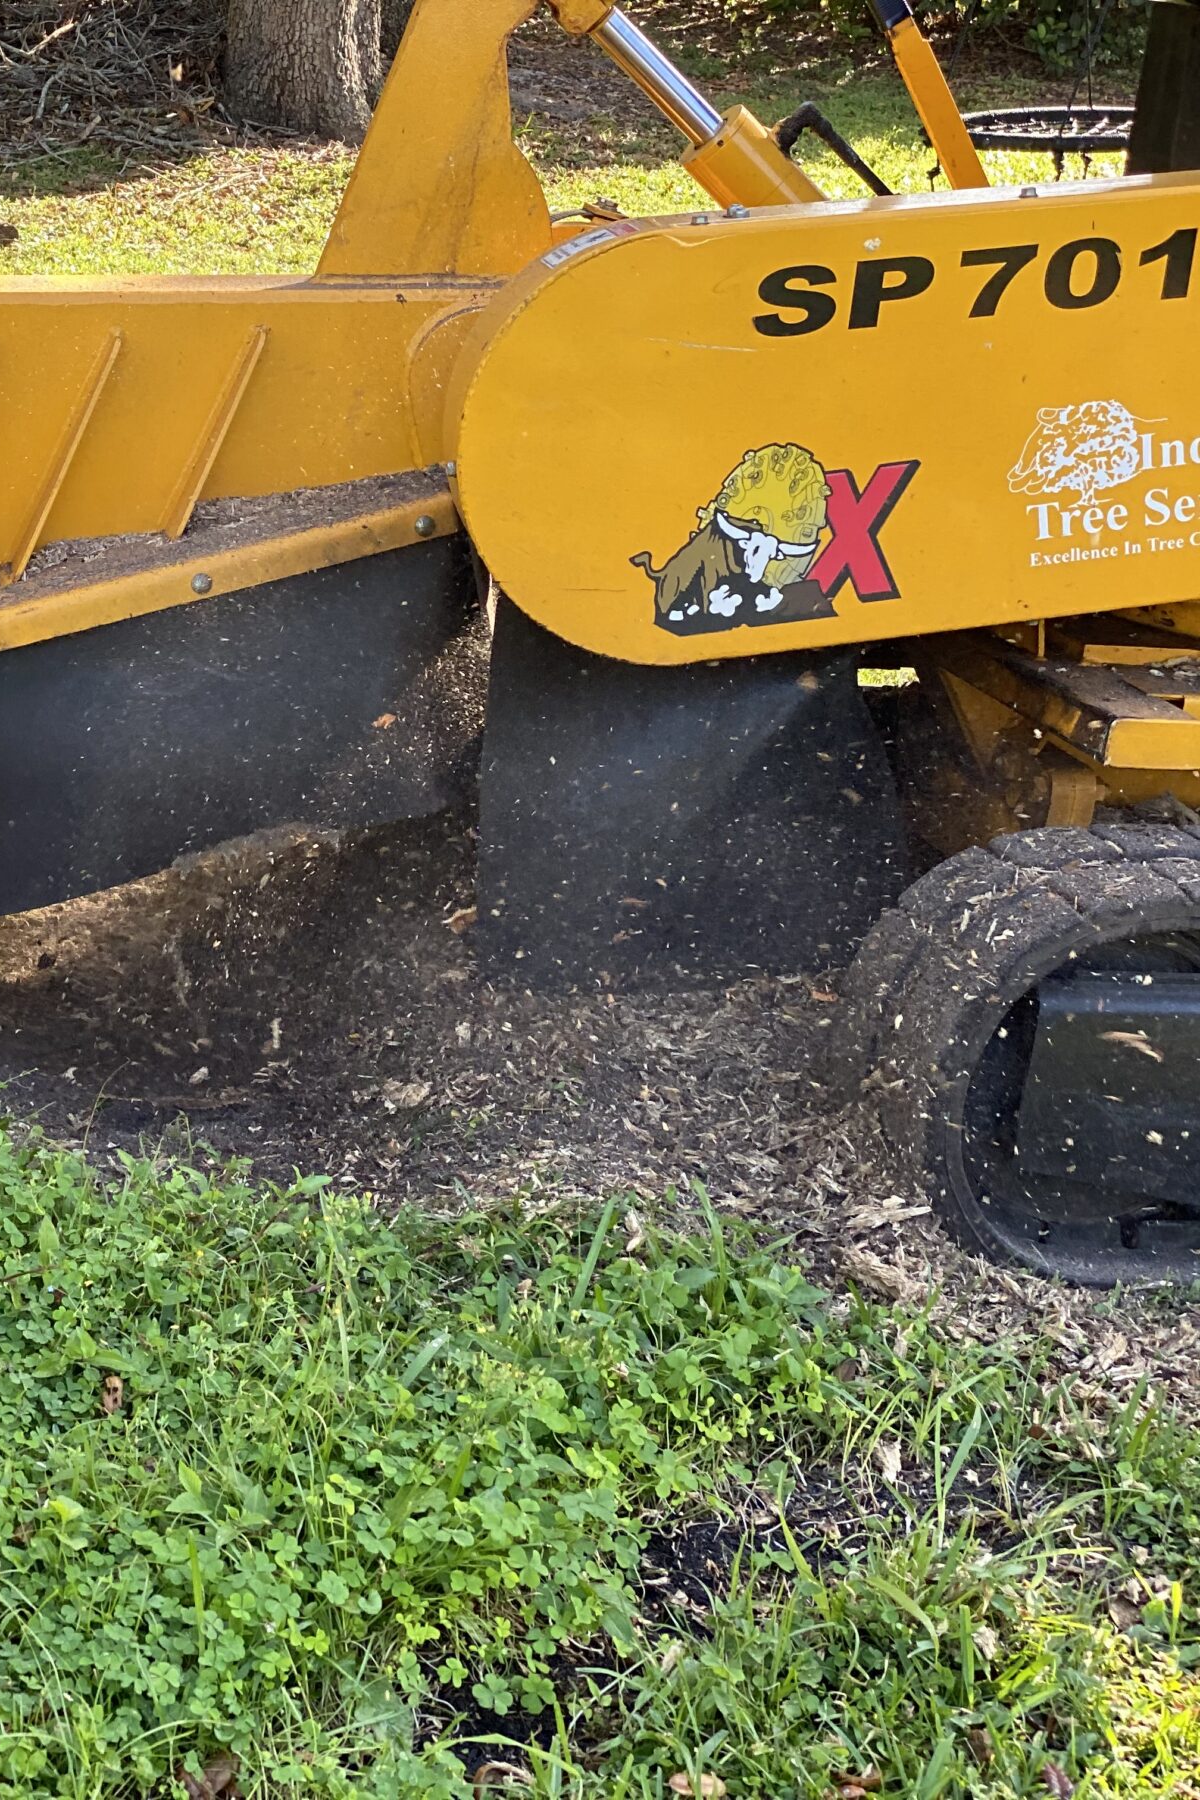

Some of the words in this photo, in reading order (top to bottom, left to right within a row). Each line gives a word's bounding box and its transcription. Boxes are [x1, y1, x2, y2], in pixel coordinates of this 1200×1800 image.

[1026, 502, 1128, 541] Tree
[1145, 487, 1200, 526] Se
[1030, 545, 1118, 567] Excellence
[1124, 541, 1142, 555] In
[1147, 537, 1184, 552] Tree
